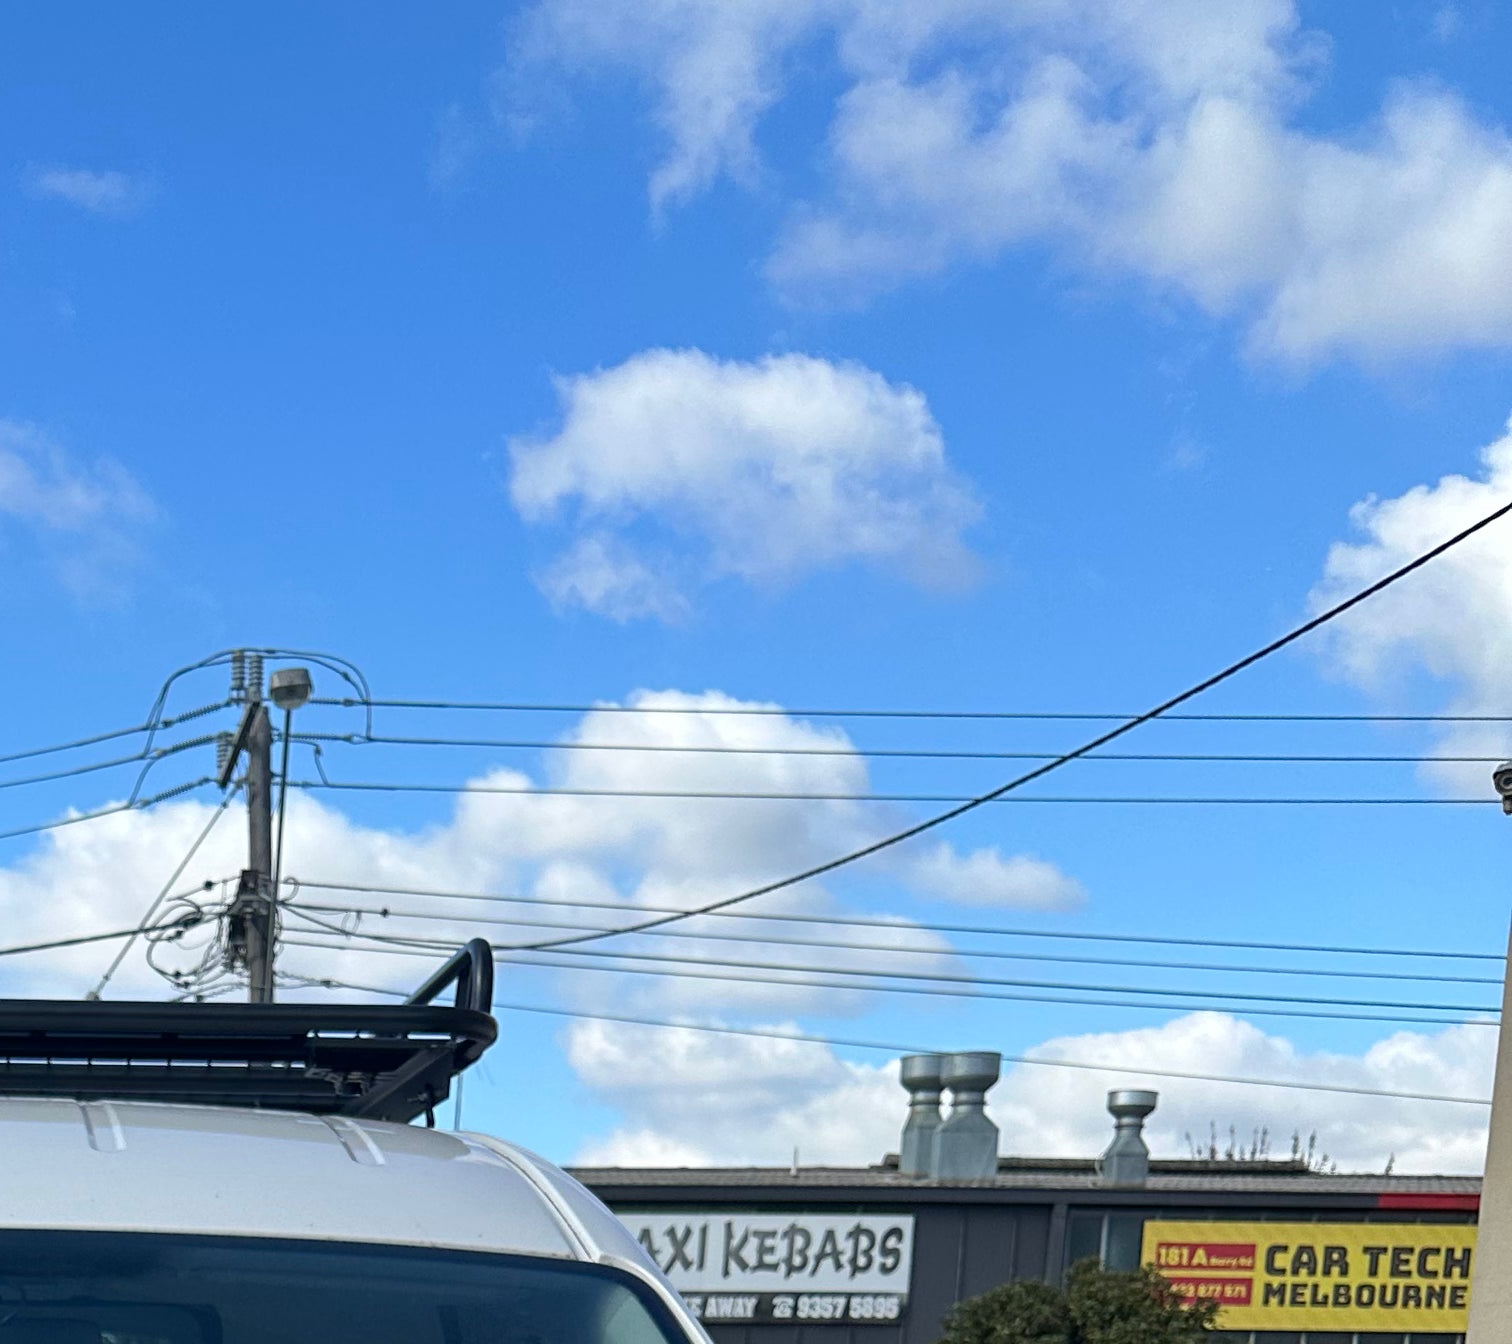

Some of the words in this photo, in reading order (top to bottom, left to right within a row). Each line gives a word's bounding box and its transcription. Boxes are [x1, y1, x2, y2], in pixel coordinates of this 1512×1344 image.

[637, 1222, 708, 1276] AXI
[720, 1219, 904, 1280] KEBABS
[1191, 1247, 1209, 1267] A
[1264, 1245, 1349, 1277] CAR
[1363, 1246, 1472, 1279] TECH
[704, 1297, 758, 1319] AWAY
[796, 1296, 847, 1319] 9357
[1262, 1282, 1468, 1310] MELBOURNE
